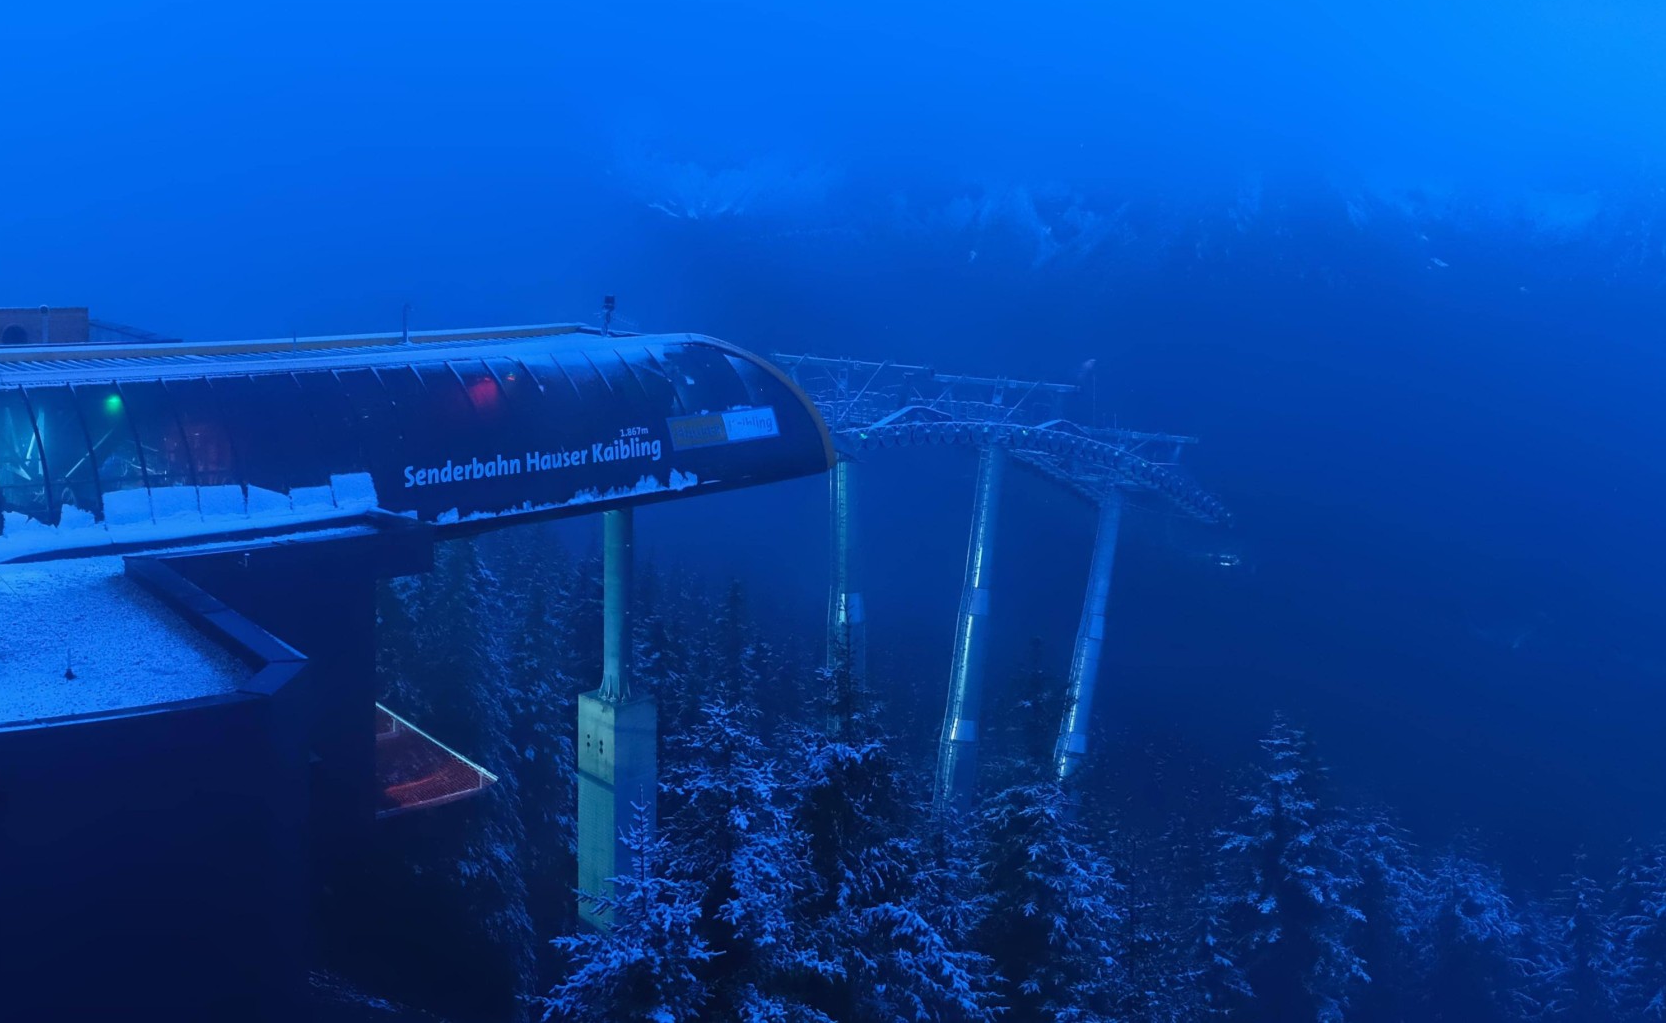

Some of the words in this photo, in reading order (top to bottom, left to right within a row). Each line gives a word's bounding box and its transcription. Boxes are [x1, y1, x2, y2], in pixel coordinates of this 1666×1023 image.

[619, 426, 649, 438] 1.867m
[403, 454, 521, 488] Senderbahn
[526, 447, 588, 472] Hauser
[592, 437, 662, 463] Kaibling
